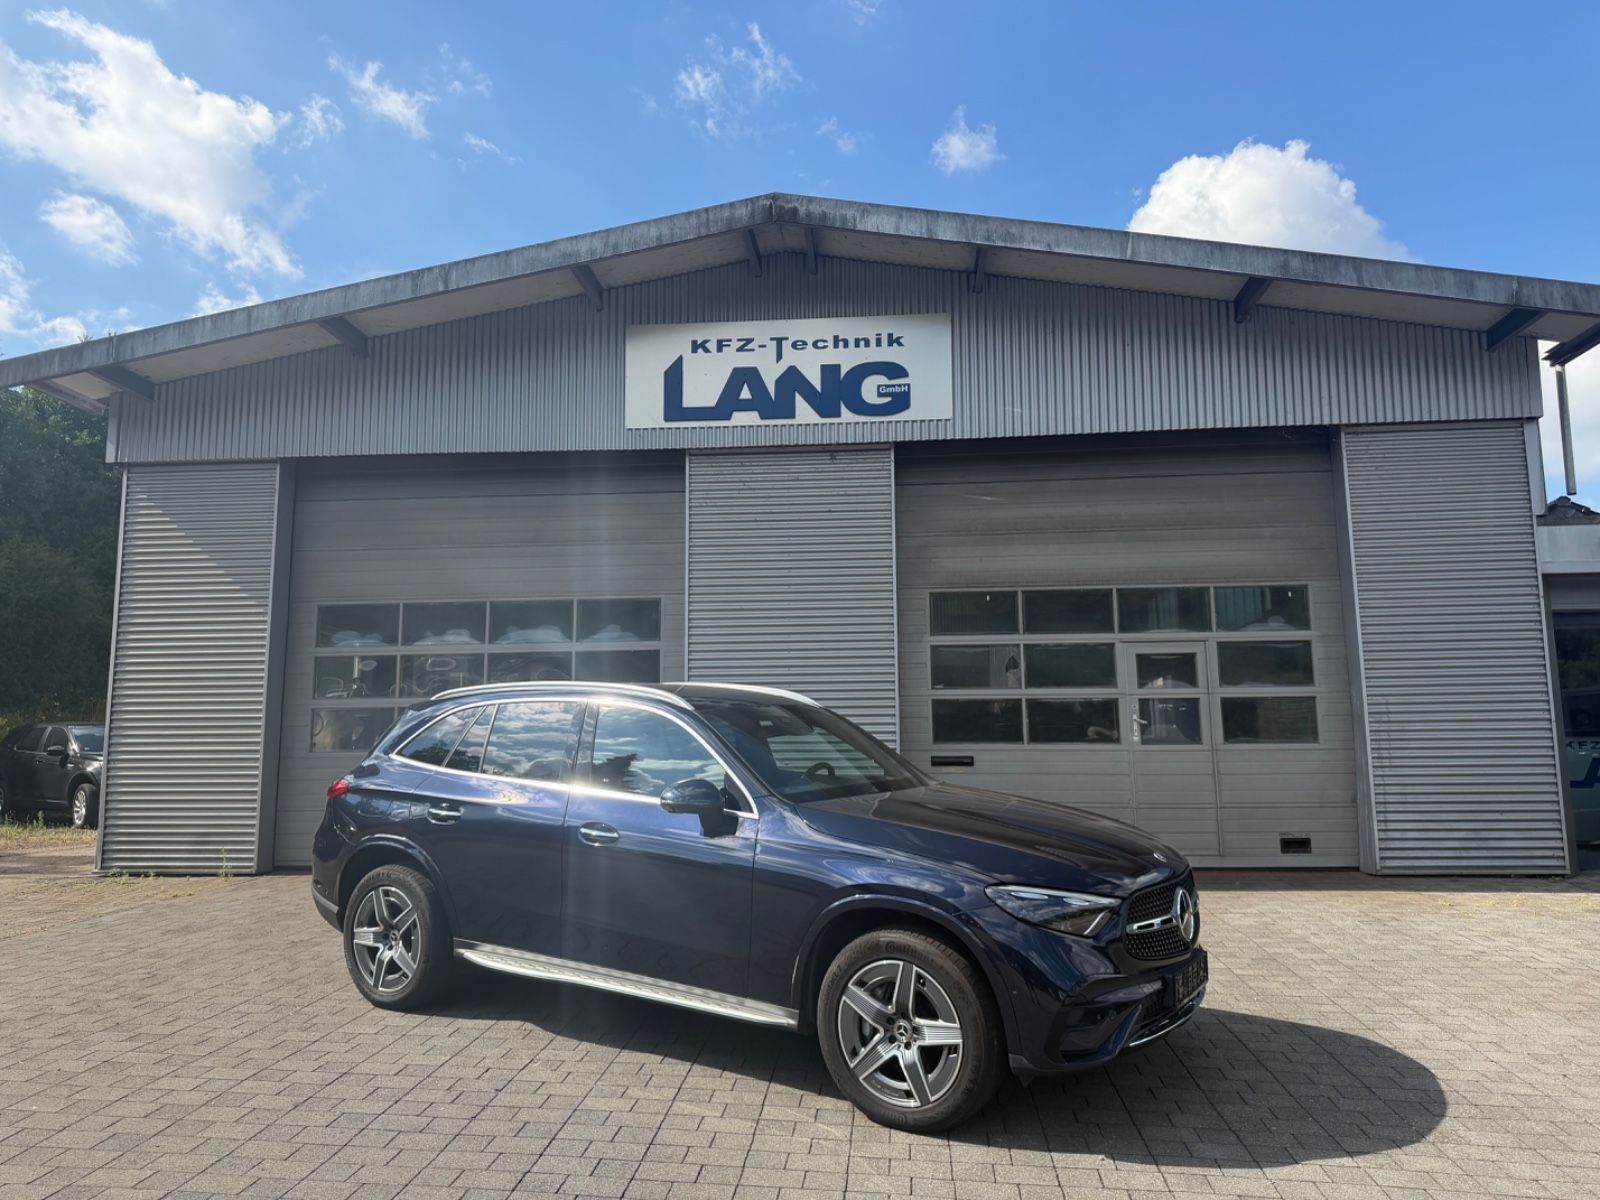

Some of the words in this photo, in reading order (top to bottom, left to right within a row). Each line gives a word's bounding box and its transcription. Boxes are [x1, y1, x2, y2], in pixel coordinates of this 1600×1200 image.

[690, 332, 905, 364] KFZ-Technik
[663, 354, 911, 422] LANG
[879, 384, 909, 393] GmbH
